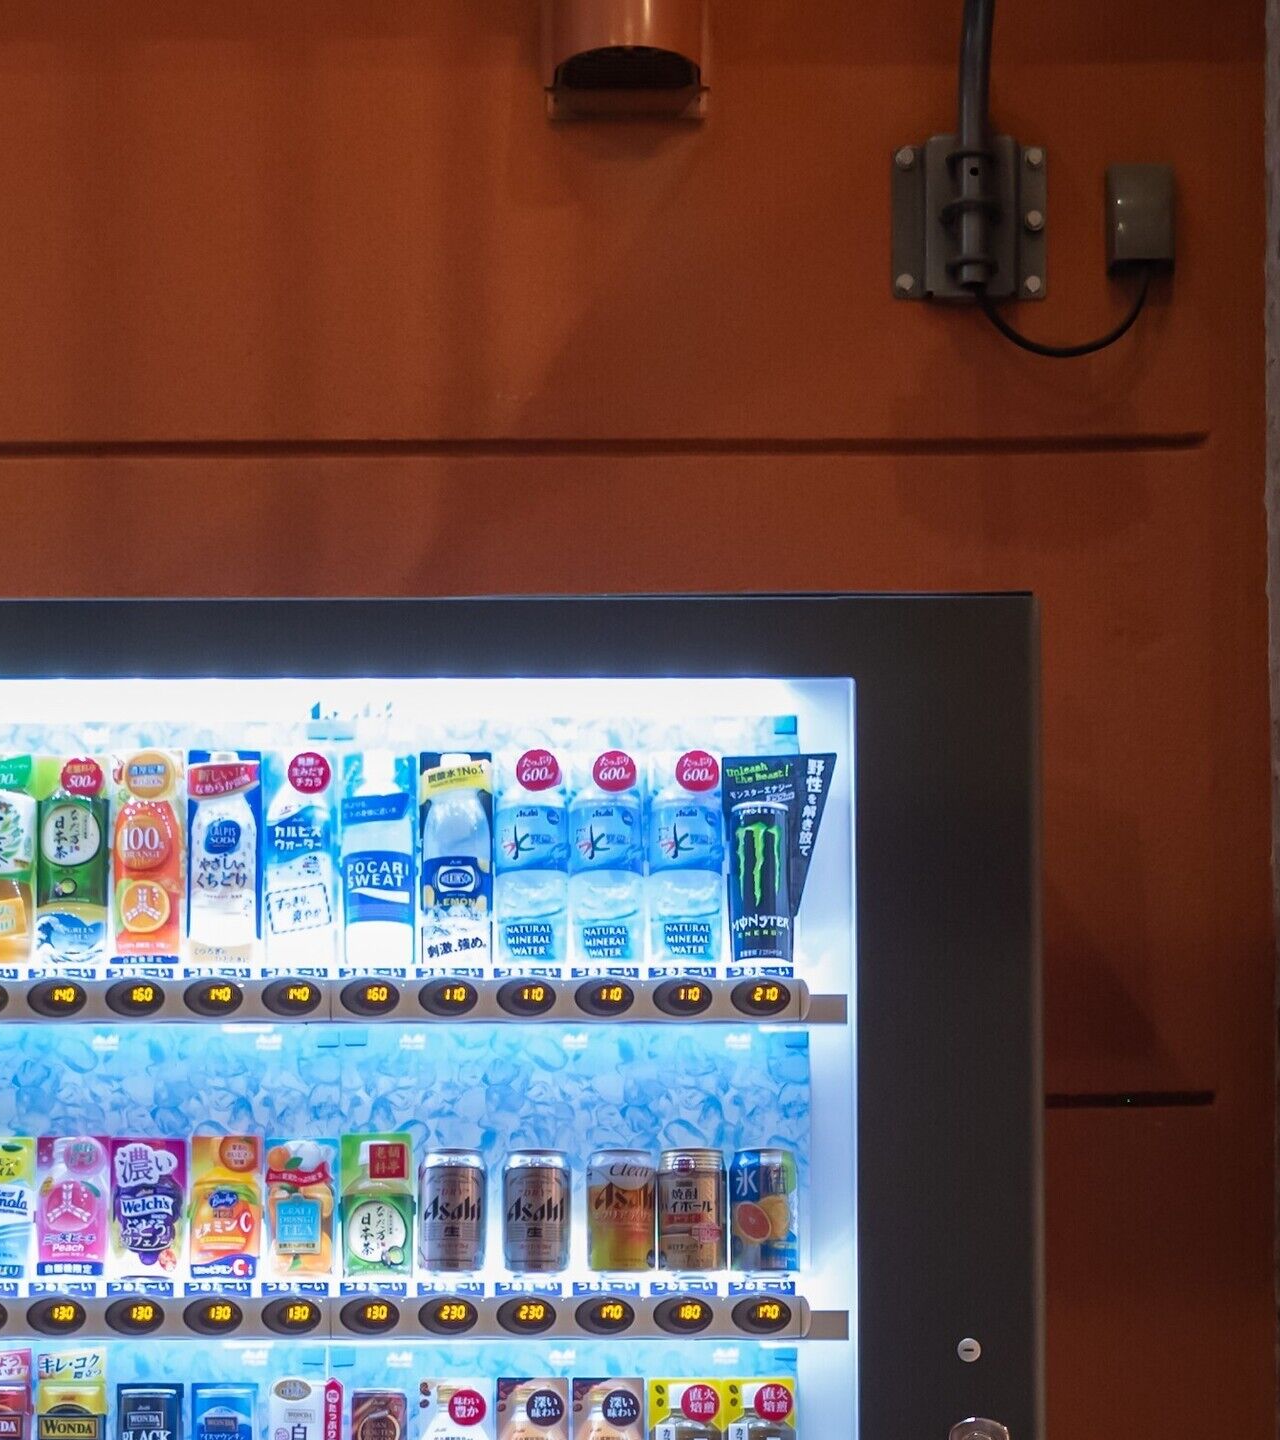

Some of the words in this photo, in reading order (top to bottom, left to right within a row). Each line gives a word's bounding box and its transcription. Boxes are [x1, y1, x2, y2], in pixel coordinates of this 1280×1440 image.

[798, 758, 825, 857] 野性を解き放て
[209, 826, 237, 837] CALPIS
[274, 824, 322, 838] カルピス
[274, 838, 322, 851] ウォーター
[199, 854, 246, 871] やさしい
[347, 860, 409, 875] POCARI
[196, 871, 248, 889] くちどけ
[347, 873, 405, 889] SWEAT
[506, 925, 552, 935] NATURAL
[664, 923, 711, 934] NATURAL
[731, 914, 790, 932] MONSTER
[583, 926, 628, 937] NATURAL
[665, 934, 710, 944] MINERAL
[427, 936, 487, 958] 刺激、強め。
[507, 935, 551, 945] MINERAL
[585, 936, 627, 947] MINERAL
[512, 946, 546, 957] WATER
[589, 947, 622, 958] WATER
[671, 944, 705, 955] WATER
[54, 987, 75, 1002] 140
[132, 987, 153, 1002] 160
[210, 986, 231, 1002] 140
[288, 986, 310, 1001] 140
[367, 987, 388, 1001] 160
[445, 987, 466, 1002] 110
[523, 987, 544, 1001] 110
[601, 987, 622, 1001] 110
[680, 987, 700, 1001] 110
[753, 986, 779, 1001] 210
[119, 1147, 176, 1184] 濃い
[735, 1167, 759, 1197] 氷
[671, 1187, 698, 1200] 焼酎
[122, 1197, 170, 1214] Welch's
[423, 1195, 482, 1222] Asahi
[506, 1195, 564, 1222] Asahi
[123, 1218, 167, 1238] ぶどう
[360, 1213, 375, 1256] 日本茶
[443, 1226, 460, 1237] 生
[526, 1227, 543, 1238] 生
[51, 1243, 85, 1253] Peach
[53, 1305, 75, 1321] 130
[132, 1305, 153, 1321] 130
[210, 1305, 232, 1320] 130
[288, 1305, 310, 1320] 130
[367, 1305, 388, 1320] 130
[440, 1305, 466, 1320] 230
[519, 1304, 544, 1320] 230
[601, 1304, 623, 1320] 170
[680, 1304, 701, 1320] 180
[759, 1304, 780, 1319] 170
[39, 1353, 100, 1374] キレ・コク
[453, 1395, 480, 1406] 味わい
[534, 1395, 558, 1408] 深い
[609, 1395, 634, 1408] 深い
[689, 1389, 715, 1402] 直火
[762, 1387, 789, 1401] 直火
[454, 1405, 479, 1418] 豊か
[531, 1407, 561, 1418] 味わい
[607, 1407, 637, 1418] 味わい
[763, 1400, 789, 1413] 焙煎
[43, 1419, 93, 1434] WONDA
[130, 1414, 160, 1424] WONDA
